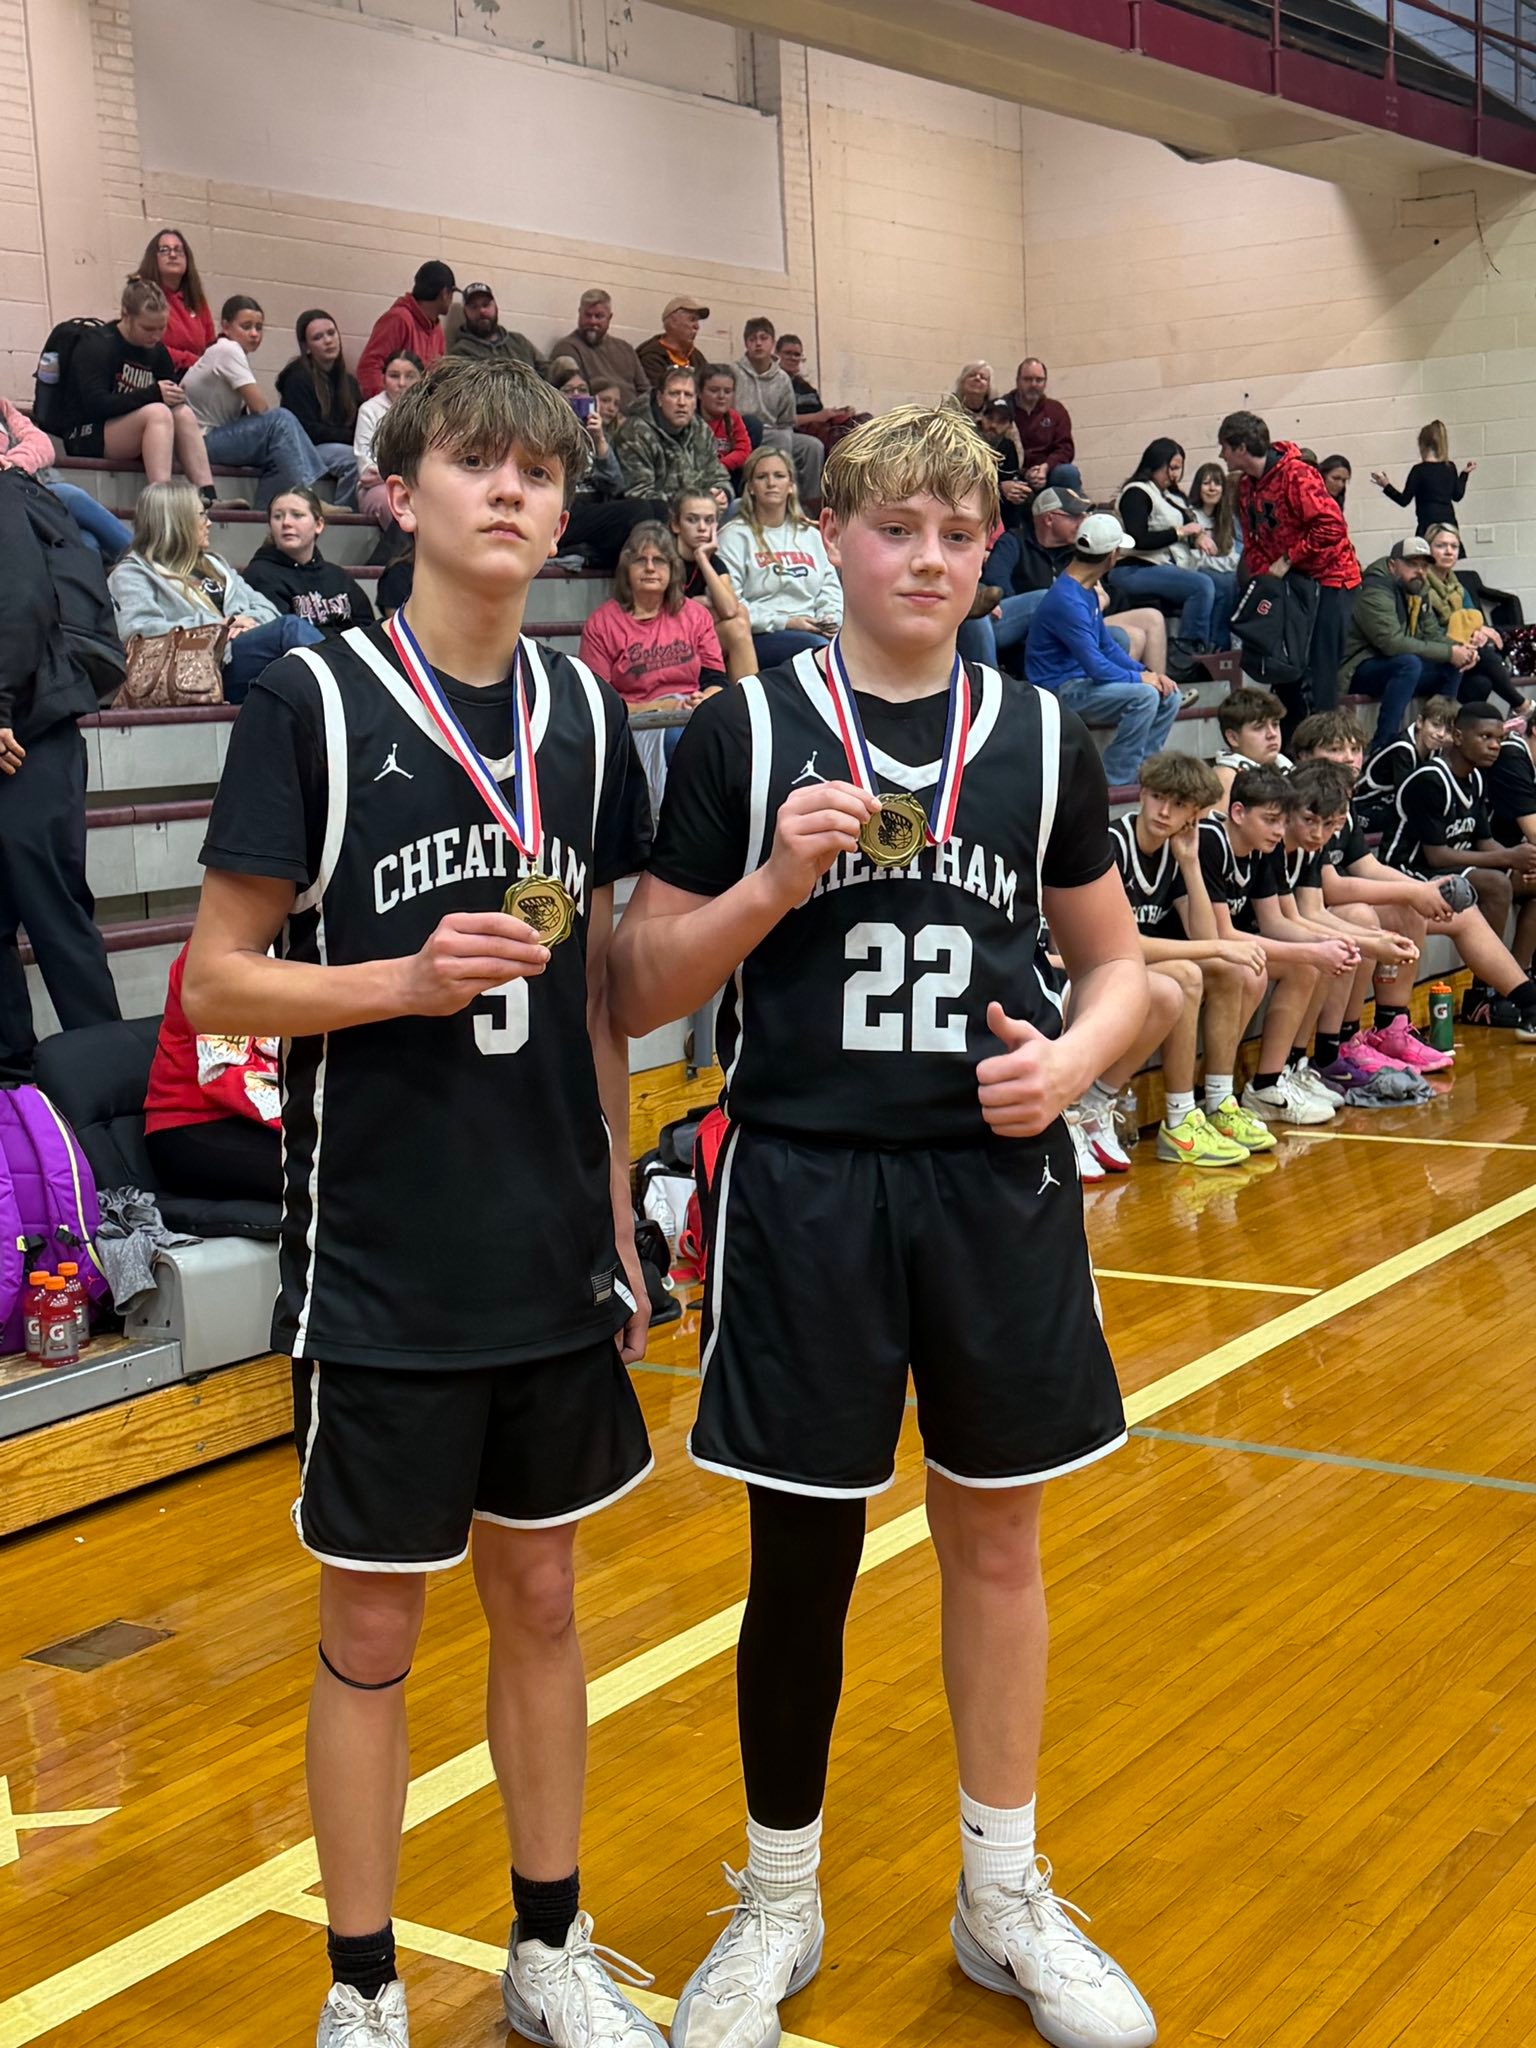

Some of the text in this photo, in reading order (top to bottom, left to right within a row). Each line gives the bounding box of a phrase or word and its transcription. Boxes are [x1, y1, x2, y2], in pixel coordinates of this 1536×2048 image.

[1257, 599, 1272, 615] C
[812, 836, 1018, 923] EHAM
[842, 922, 973, 1052] 22
[1433, 1003, 1448, 1020] G
[49, 1325, 65, 1341] G
